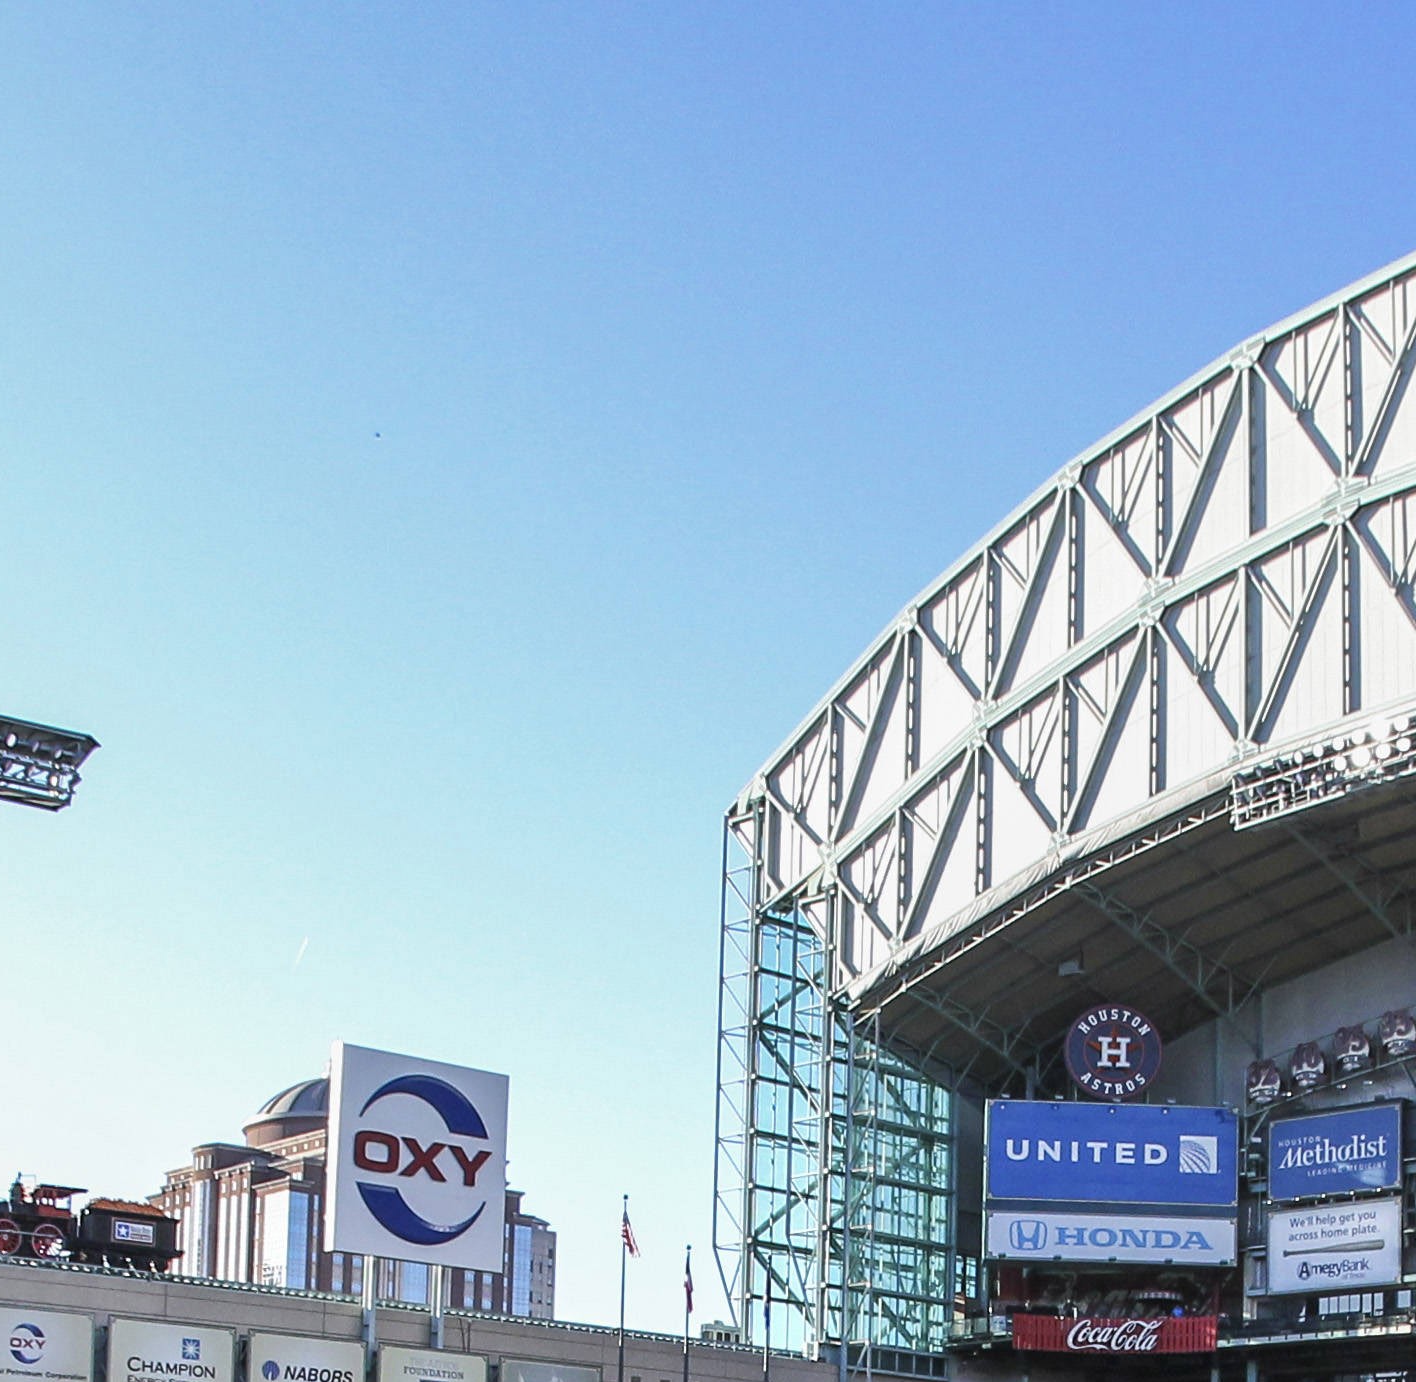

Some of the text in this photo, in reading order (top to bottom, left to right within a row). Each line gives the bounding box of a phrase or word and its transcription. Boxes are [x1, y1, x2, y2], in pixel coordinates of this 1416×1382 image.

[1078, 1009, 1151, 1036] HOUSTON
[1097, 1036, 1131, 1068] H
[1080, 1072, 1146, 1095] ASTROS
[1006, 1139, 1168, 1165] UNITED
[1278, 1136, 1321, 1147] HOUSTON
[1279, 1134, 1387, 1169] Methodist
[354, 1130, 492, 1187] OXY
[1289, 1210, 1377, 1228] We'll help get you
[1055, 1226, 1214, 1250] HONDA
[1288, 1229, 1319, 1241] across
[1321, 1226, 1349, 1239] home
[9, 1337, 47, 1350] OXY
[126, 1356, 216, 1379] CHAMPION
[403, 1366, 465, 1381] FOUNDATION
